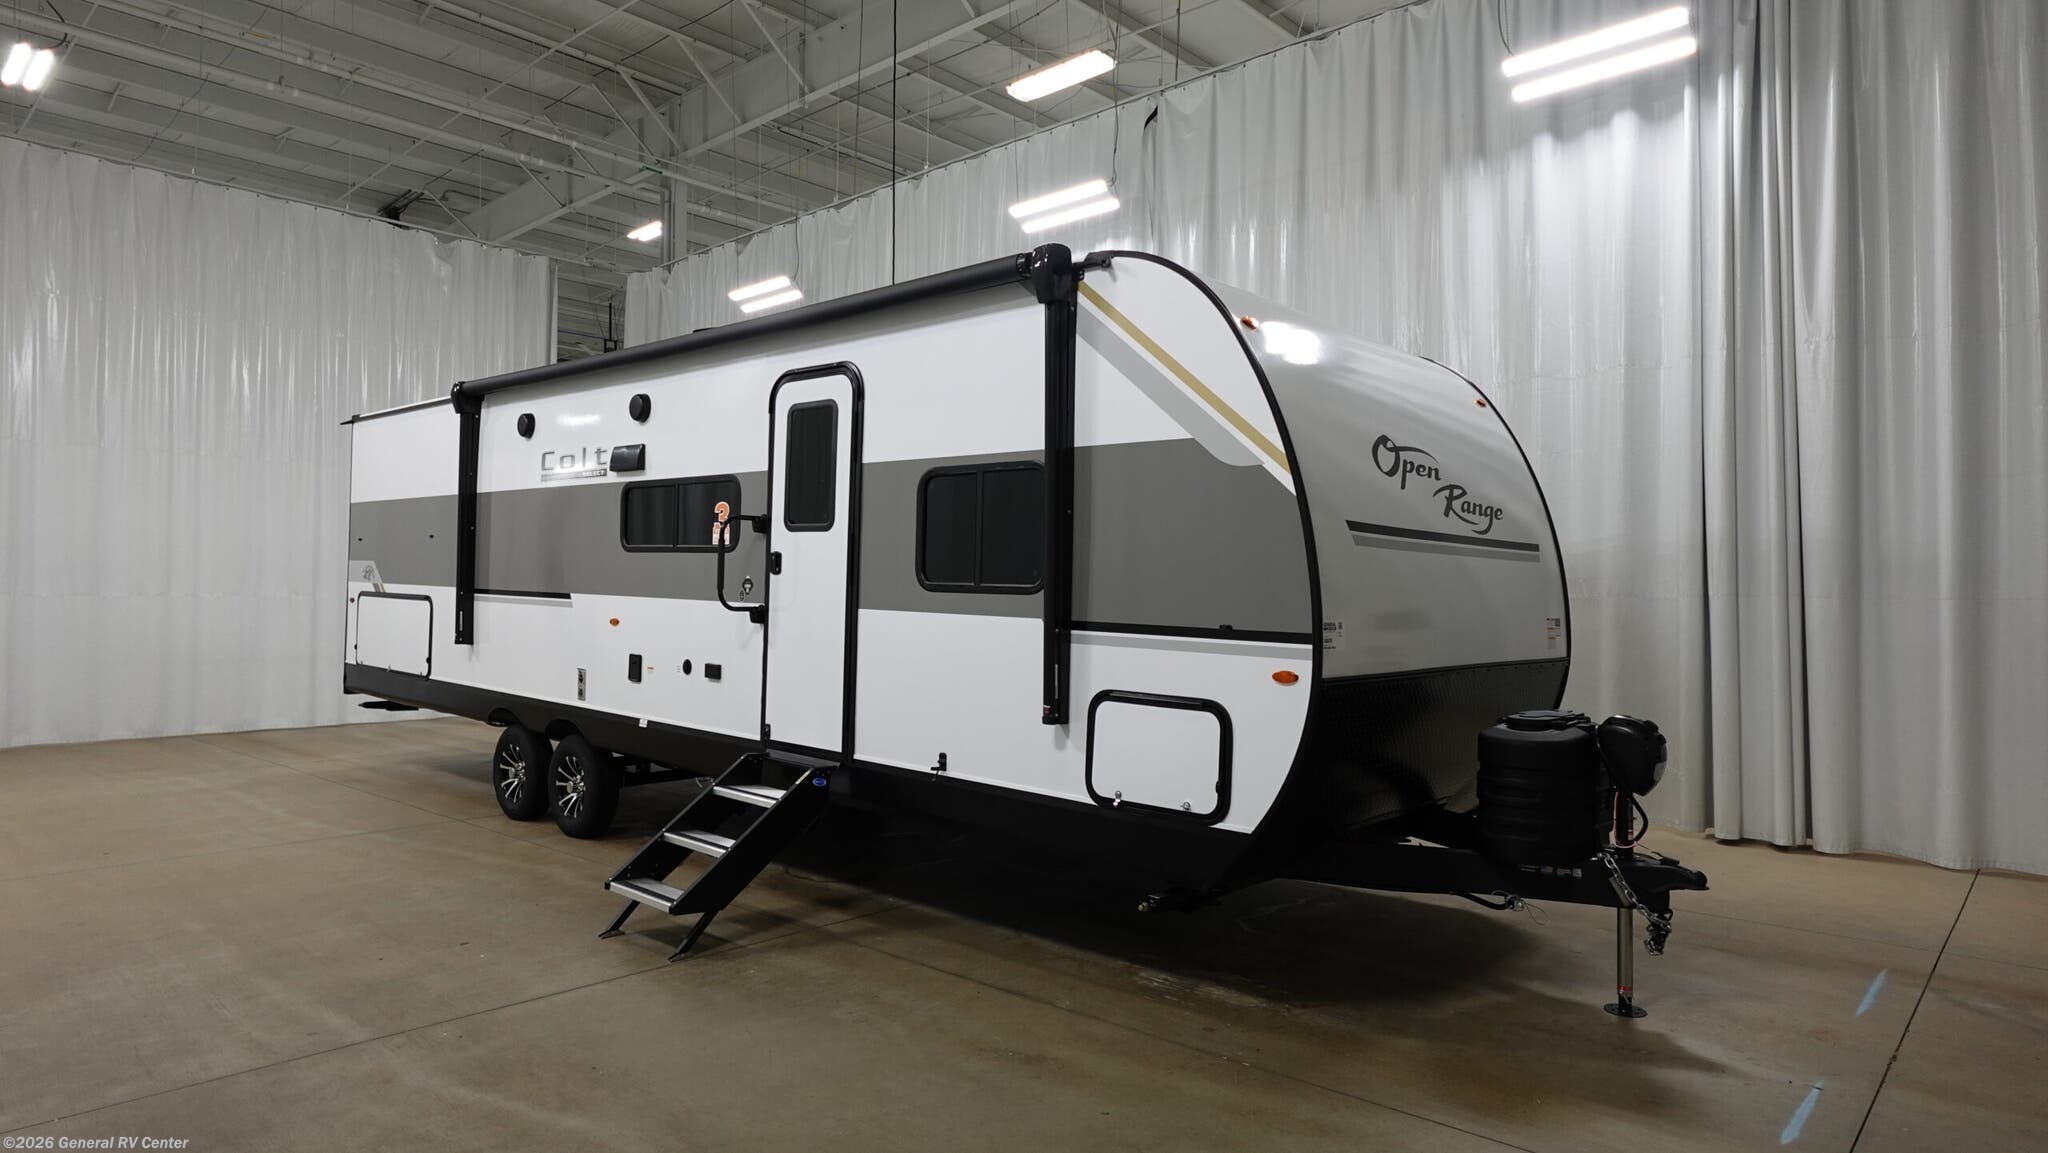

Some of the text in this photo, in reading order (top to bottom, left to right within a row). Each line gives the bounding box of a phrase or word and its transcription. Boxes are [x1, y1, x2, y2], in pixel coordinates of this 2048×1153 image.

[541, 447, 608, 471] Colt
[1371, 434, 1441, 490] Open
[1432, 483, 1504, 535] Range
